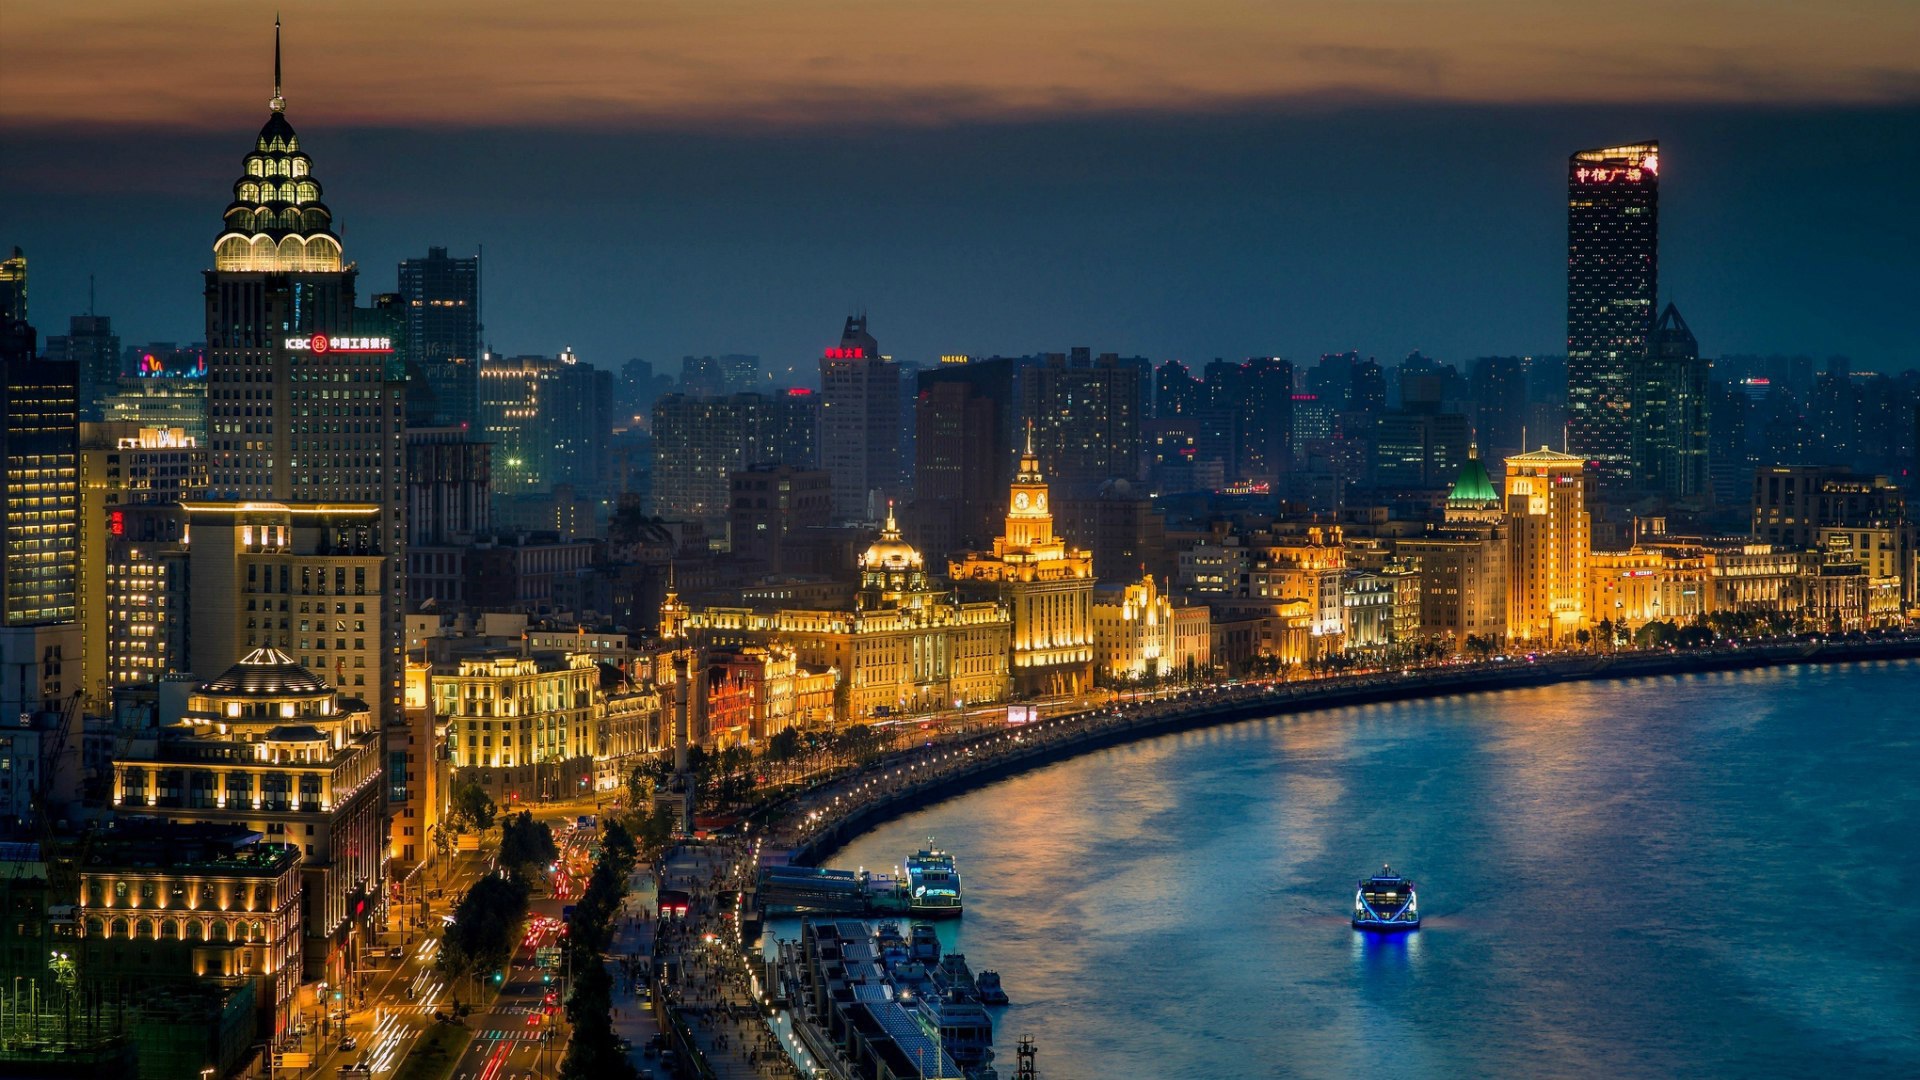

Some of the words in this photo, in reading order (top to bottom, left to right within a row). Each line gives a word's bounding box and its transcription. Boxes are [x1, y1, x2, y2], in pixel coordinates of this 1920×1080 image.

[1576, 167, 1642, 183] 中信广场
[285, 338, 311, 350] ICBC
[329, 337, 391, 350] 中国工商银行
